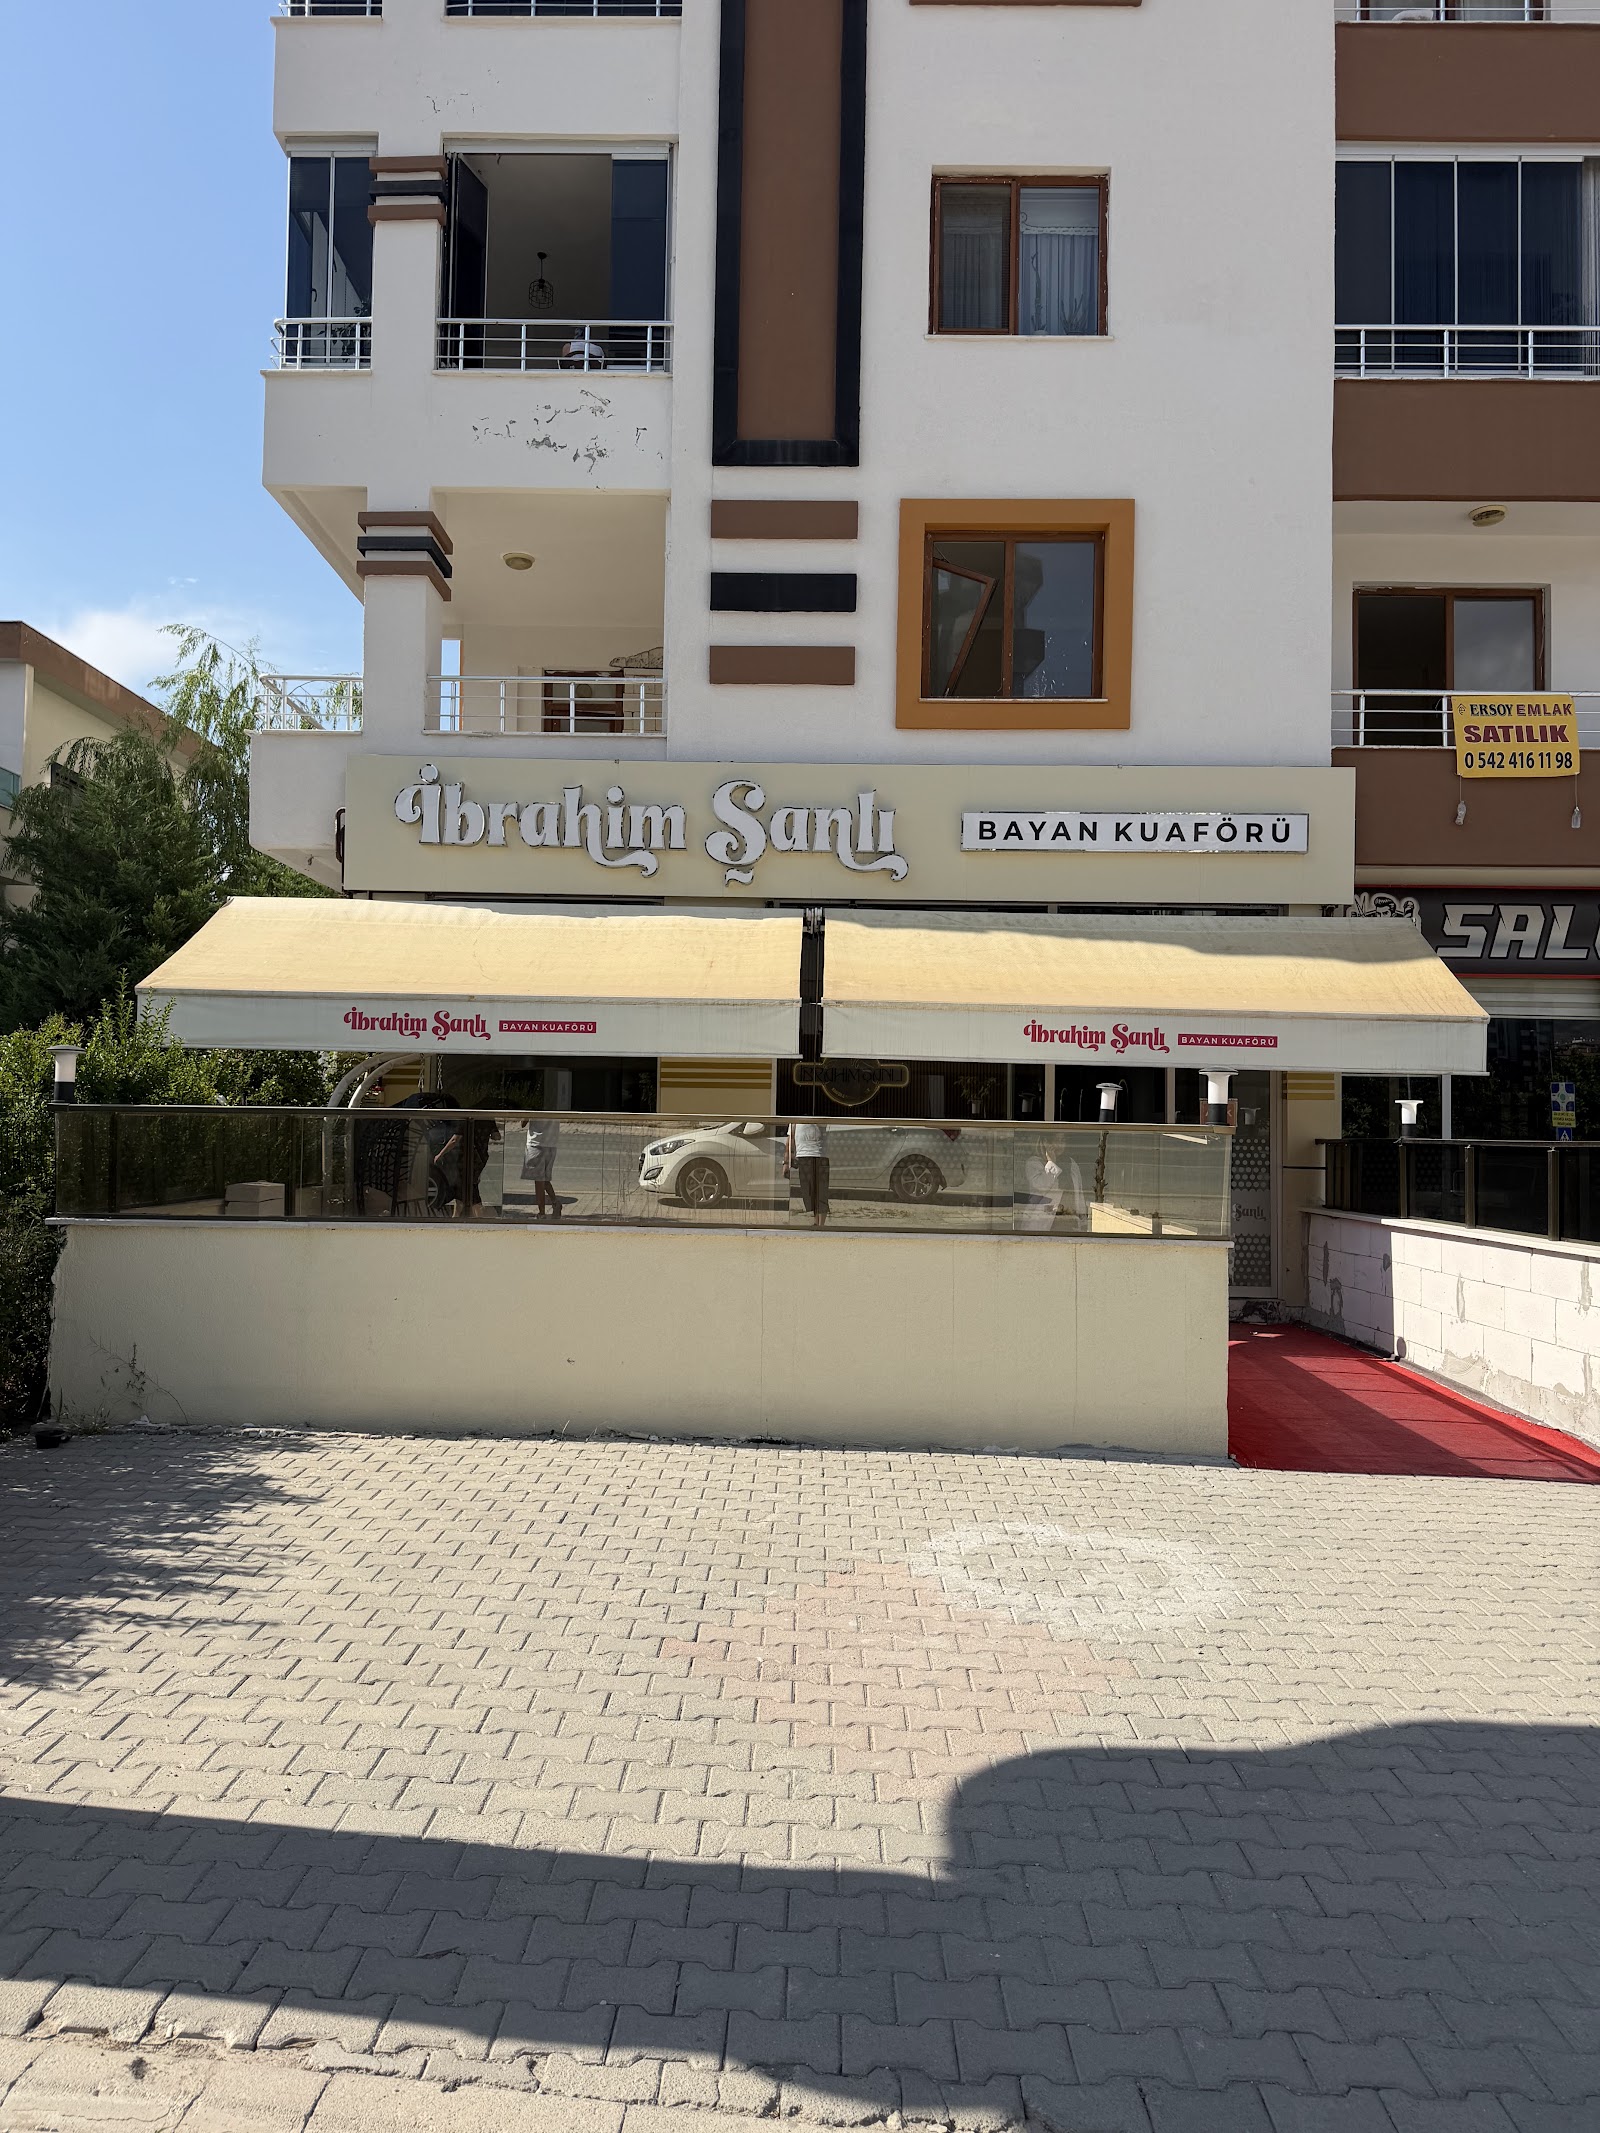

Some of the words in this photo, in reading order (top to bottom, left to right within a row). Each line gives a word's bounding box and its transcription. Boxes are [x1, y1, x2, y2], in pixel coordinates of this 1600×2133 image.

[1469, 703, 1514, 717] ERSOY
[1516, 703, 1573, 717] EMLAK
[1463, 724, 1570, 744] SATILIK
[1465, 751, 1474, 769] 0
[1478, 751, 1505, 769] 542
[1509, 751, 1535, 769] 416
[1538, 751, 1552, 769] 11
[1555, 751, 1573, 769] 98
[393, 762, 688, 878] İbrahim
[703, 778, 910, 887] Şanlı
[978, 820, 1099, 842] BAYAN
[1113, 816, 1293, 844] KUAFÖRÜ
[1435, 902, 1600, 960] SAL
[343, 1006, 428, 1040] İbrahim
[431, 1010, 492, 1041] Şanlı
[502, 1023, 539, 1031] BAYAN
[541, 1023, 594, 1032] KUAFÖRÜ
[1023, 1019, 1106, 1052] İbrahim
[1110, 1023, 1171, 1055] Şanlı
[1181, 1036, 1219, 1045] BAYAN
[1221, 1037, 1276, 1046] KUAFÖRÜ
